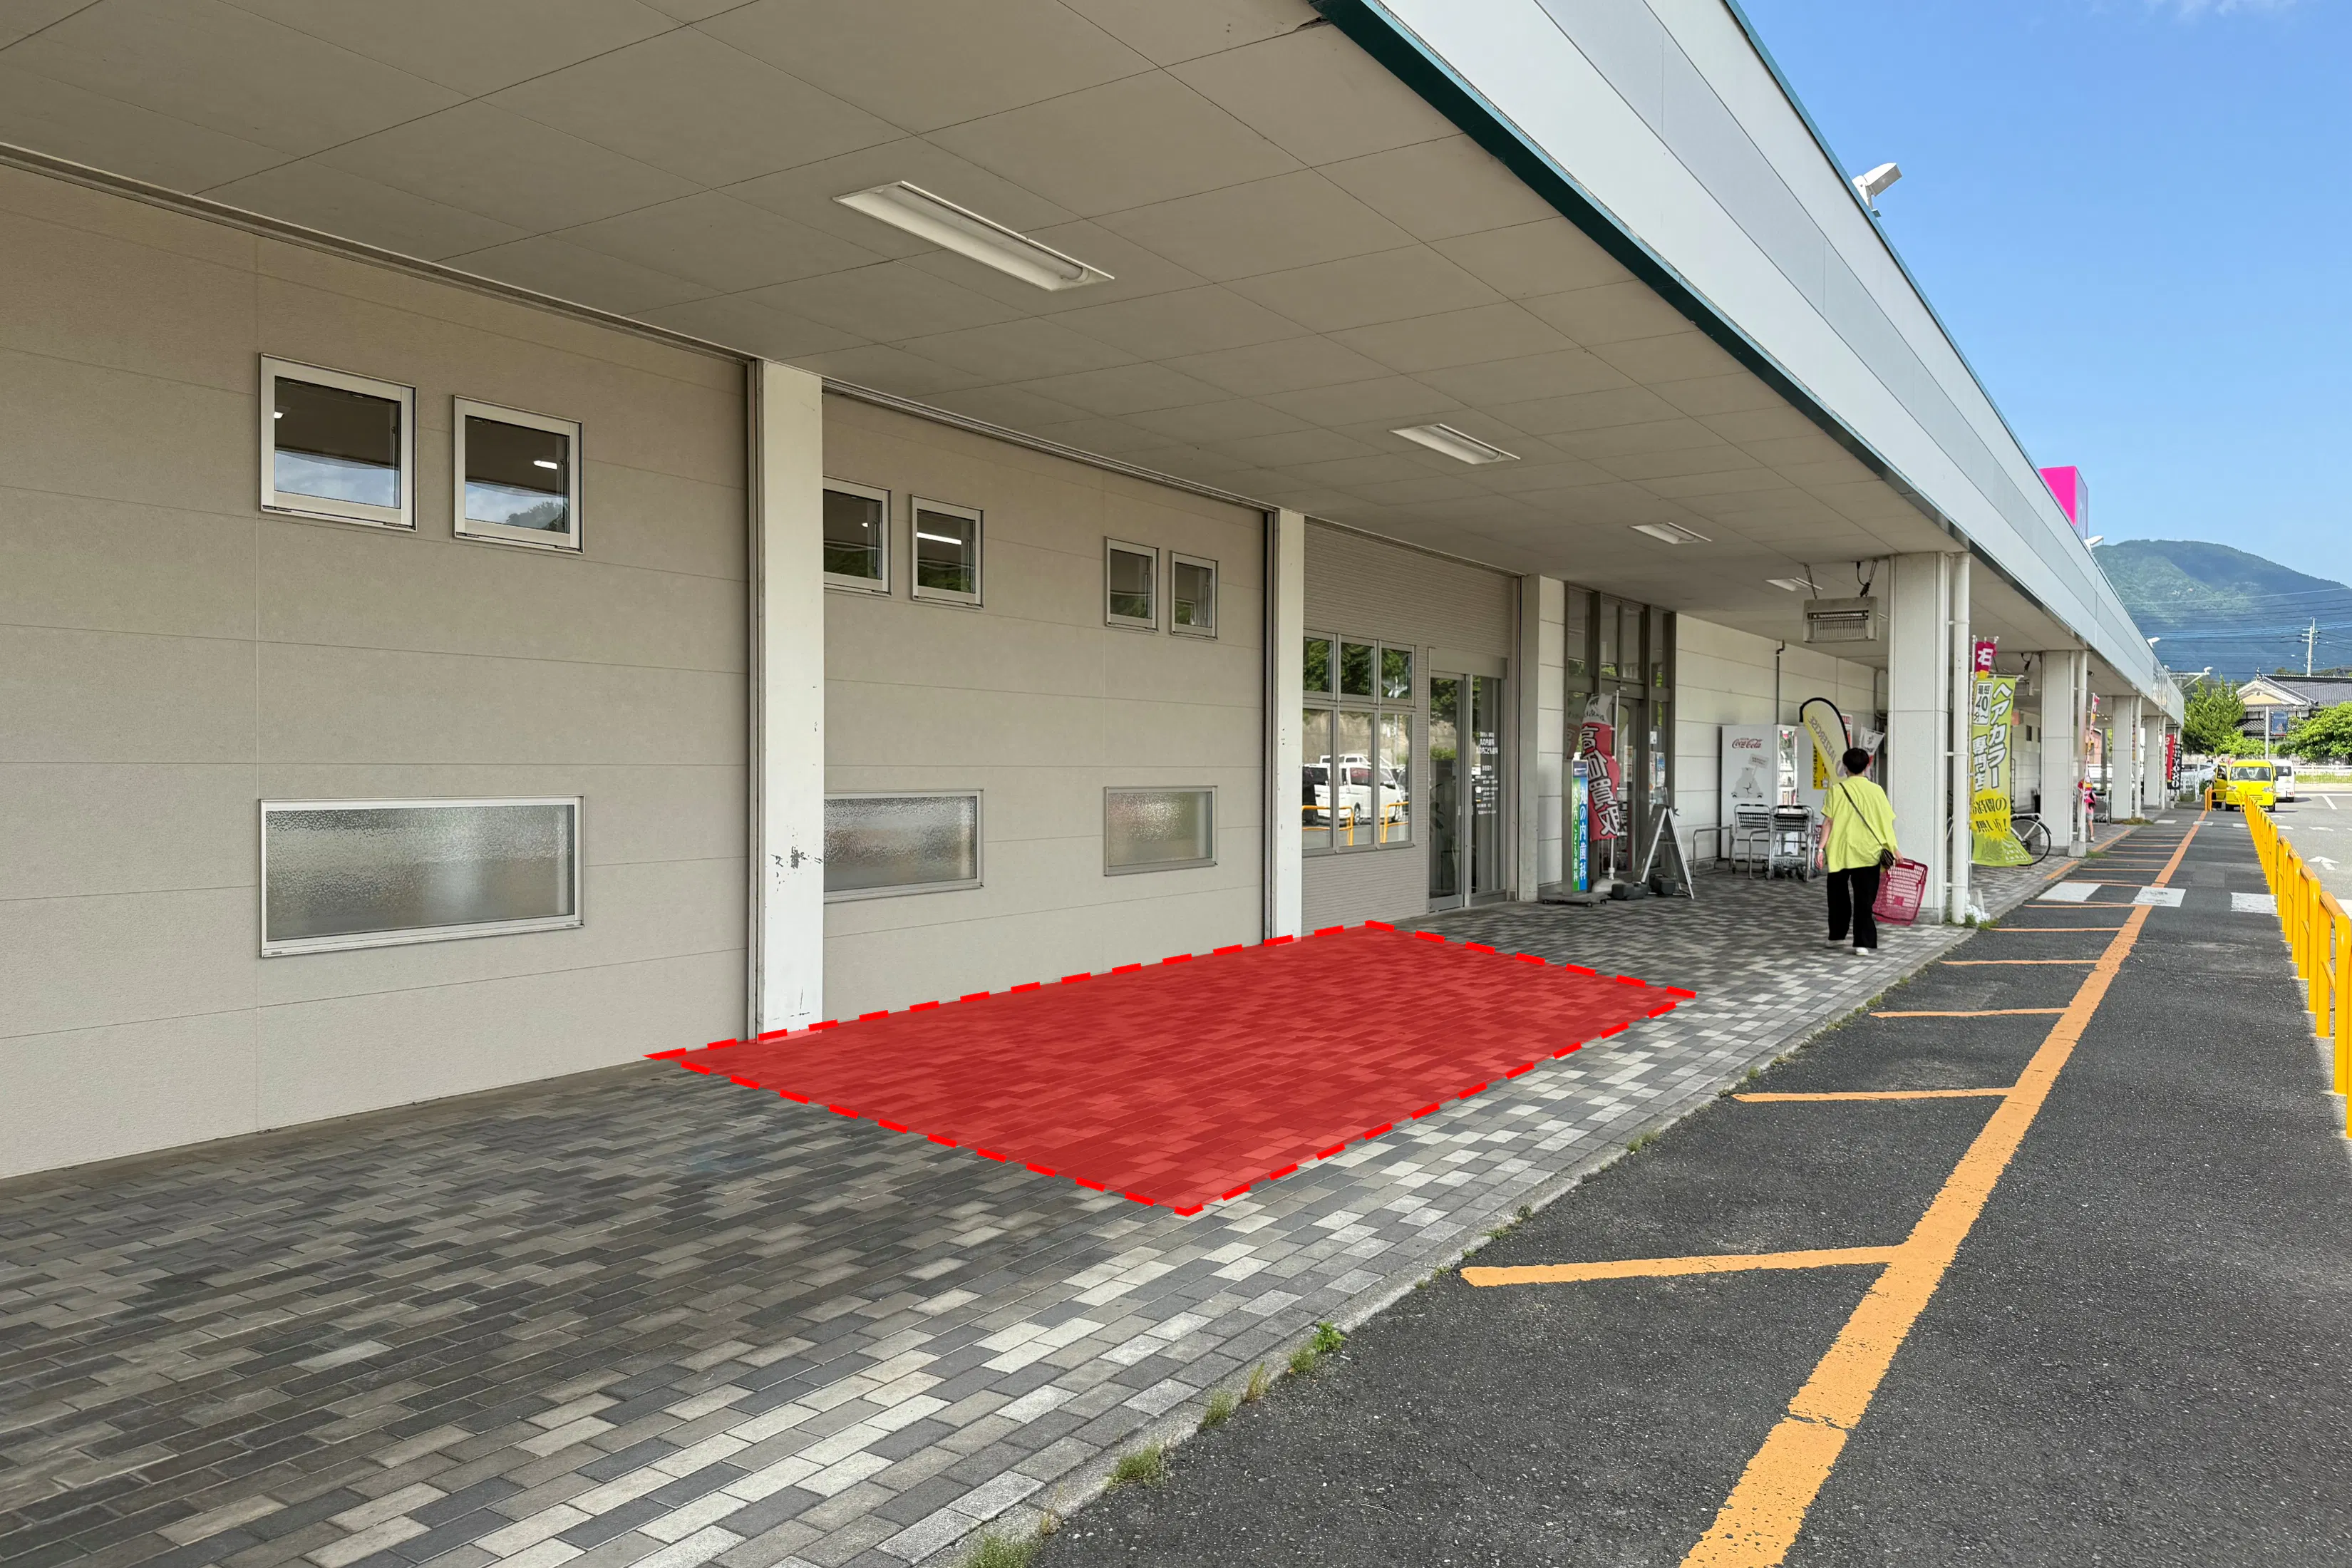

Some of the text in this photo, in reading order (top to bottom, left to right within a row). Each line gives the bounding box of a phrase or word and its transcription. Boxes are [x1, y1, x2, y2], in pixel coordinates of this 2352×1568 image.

[1988, 682, 2013, 789] ヘアカラー
